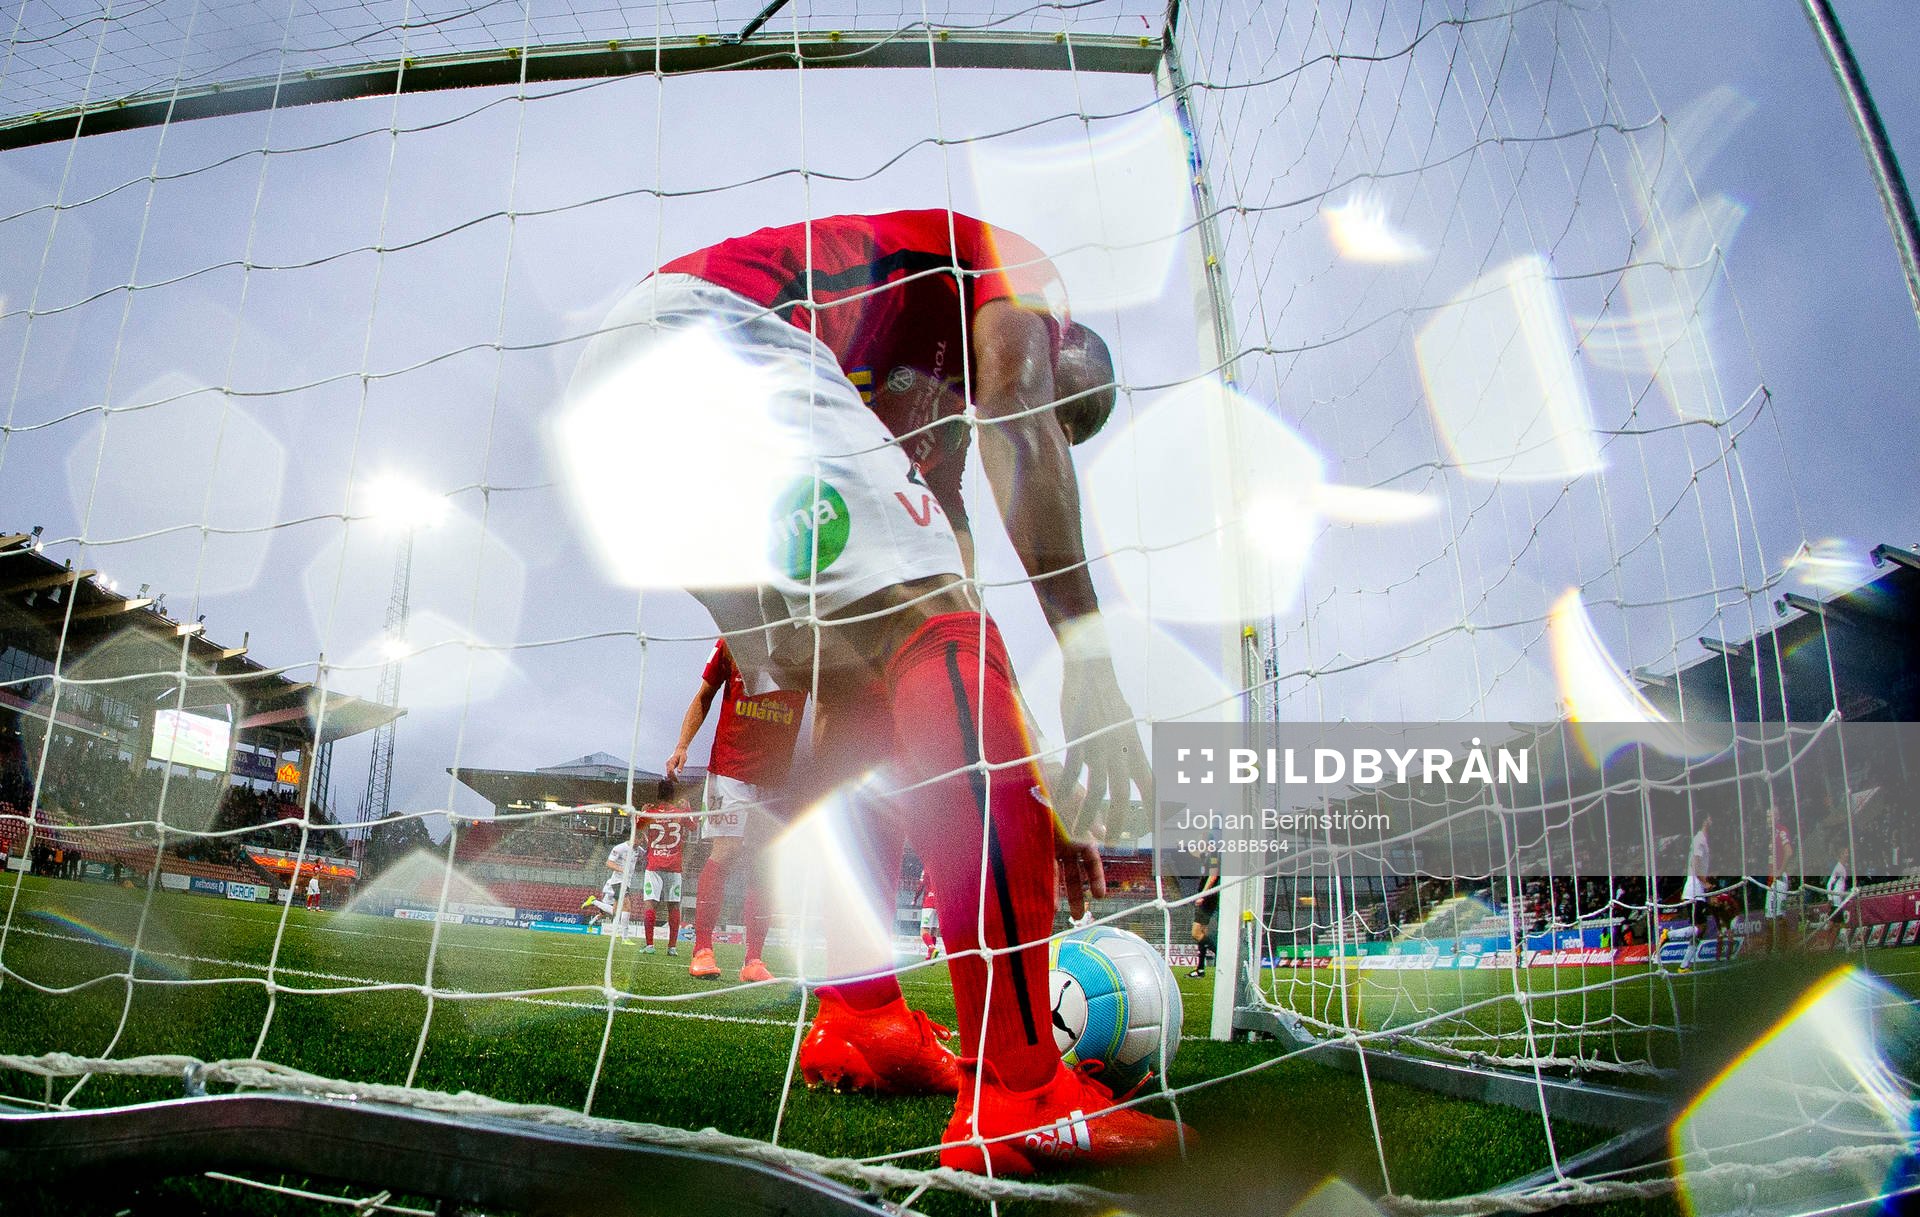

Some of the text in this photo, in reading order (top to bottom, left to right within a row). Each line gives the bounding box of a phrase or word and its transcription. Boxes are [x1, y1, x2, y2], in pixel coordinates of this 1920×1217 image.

[735, 700, 794, 725] Ullared
[650, 823, 682, 849] 23
[519, 913, 543, 921] KPMG
[553, 916, 577, 924] KPMG
